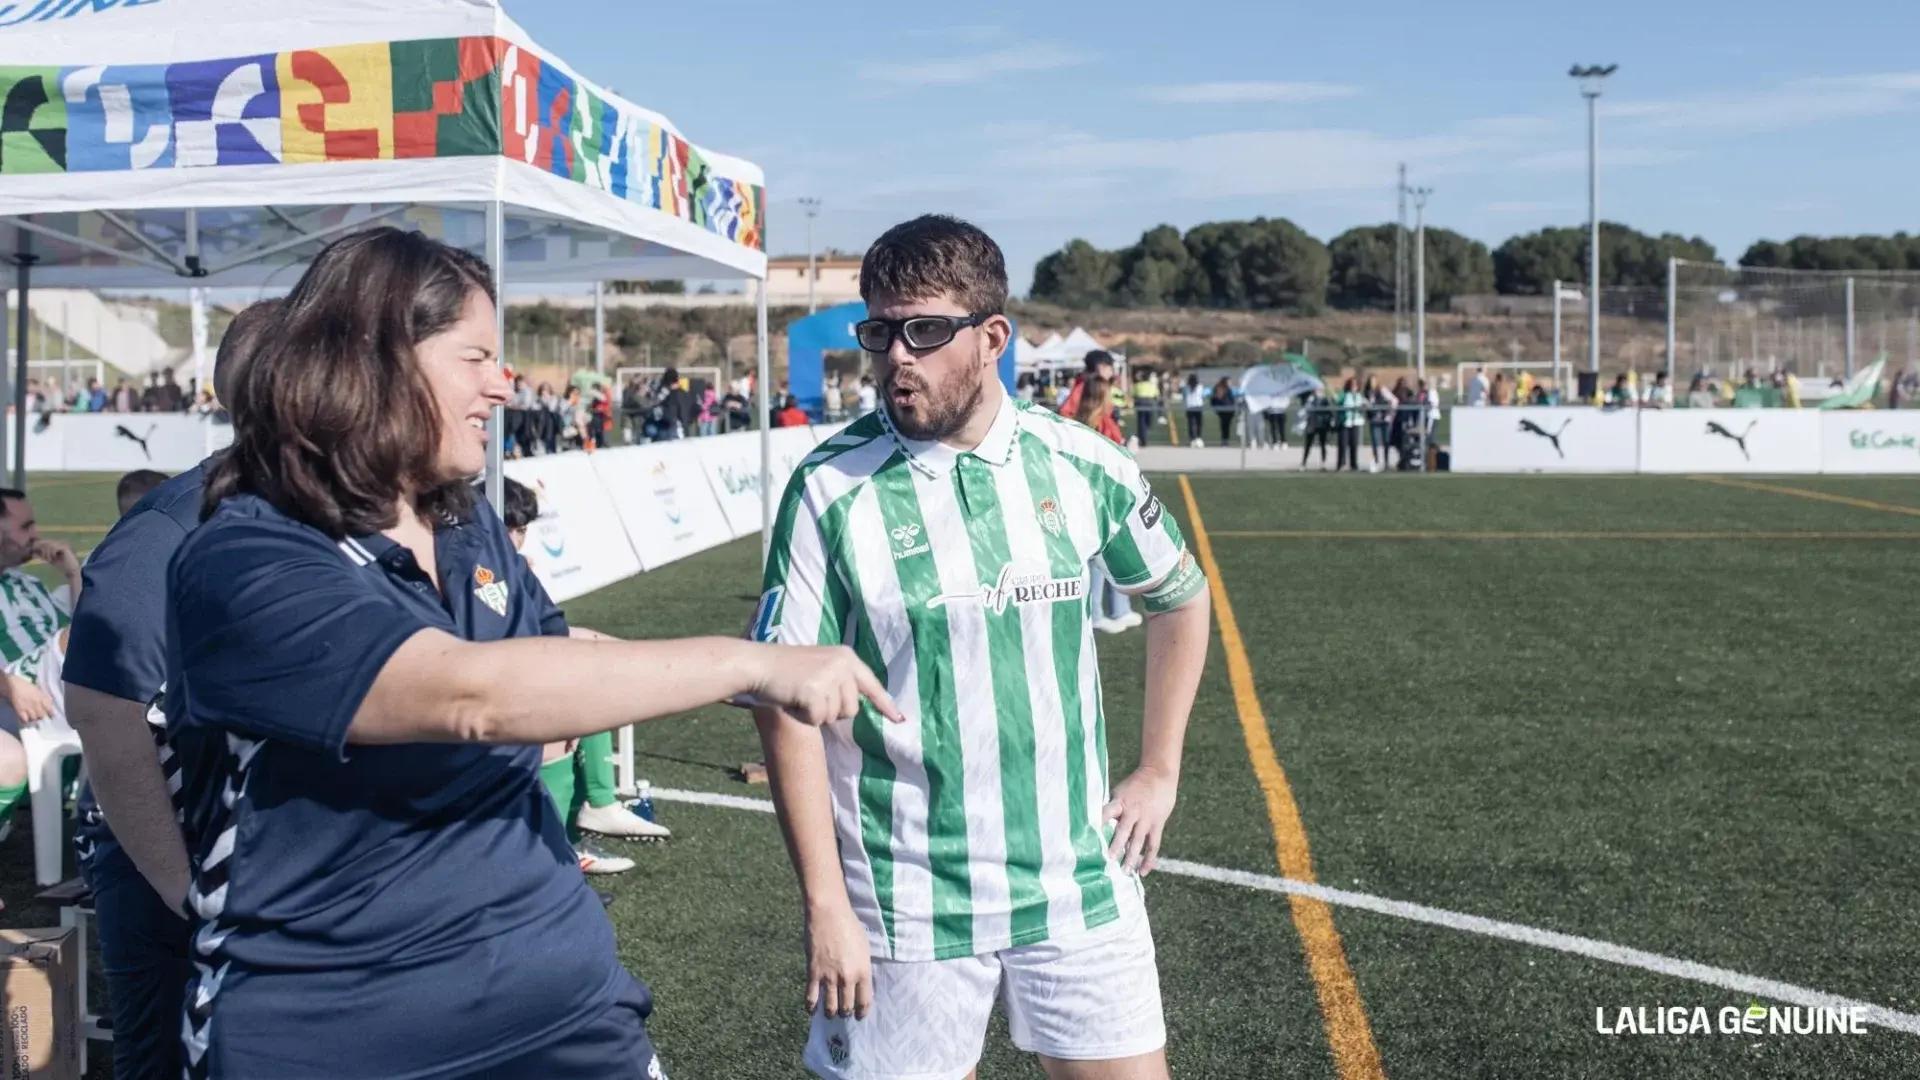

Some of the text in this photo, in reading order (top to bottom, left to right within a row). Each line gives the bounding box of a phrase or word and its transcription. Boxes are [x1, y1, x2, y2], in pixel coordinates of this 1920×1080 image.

[893, 543, 930, 561] hummel
[1015, 580, 1081, 602] RECHE
[20, 1005, 28, 1050] RECICLADO
